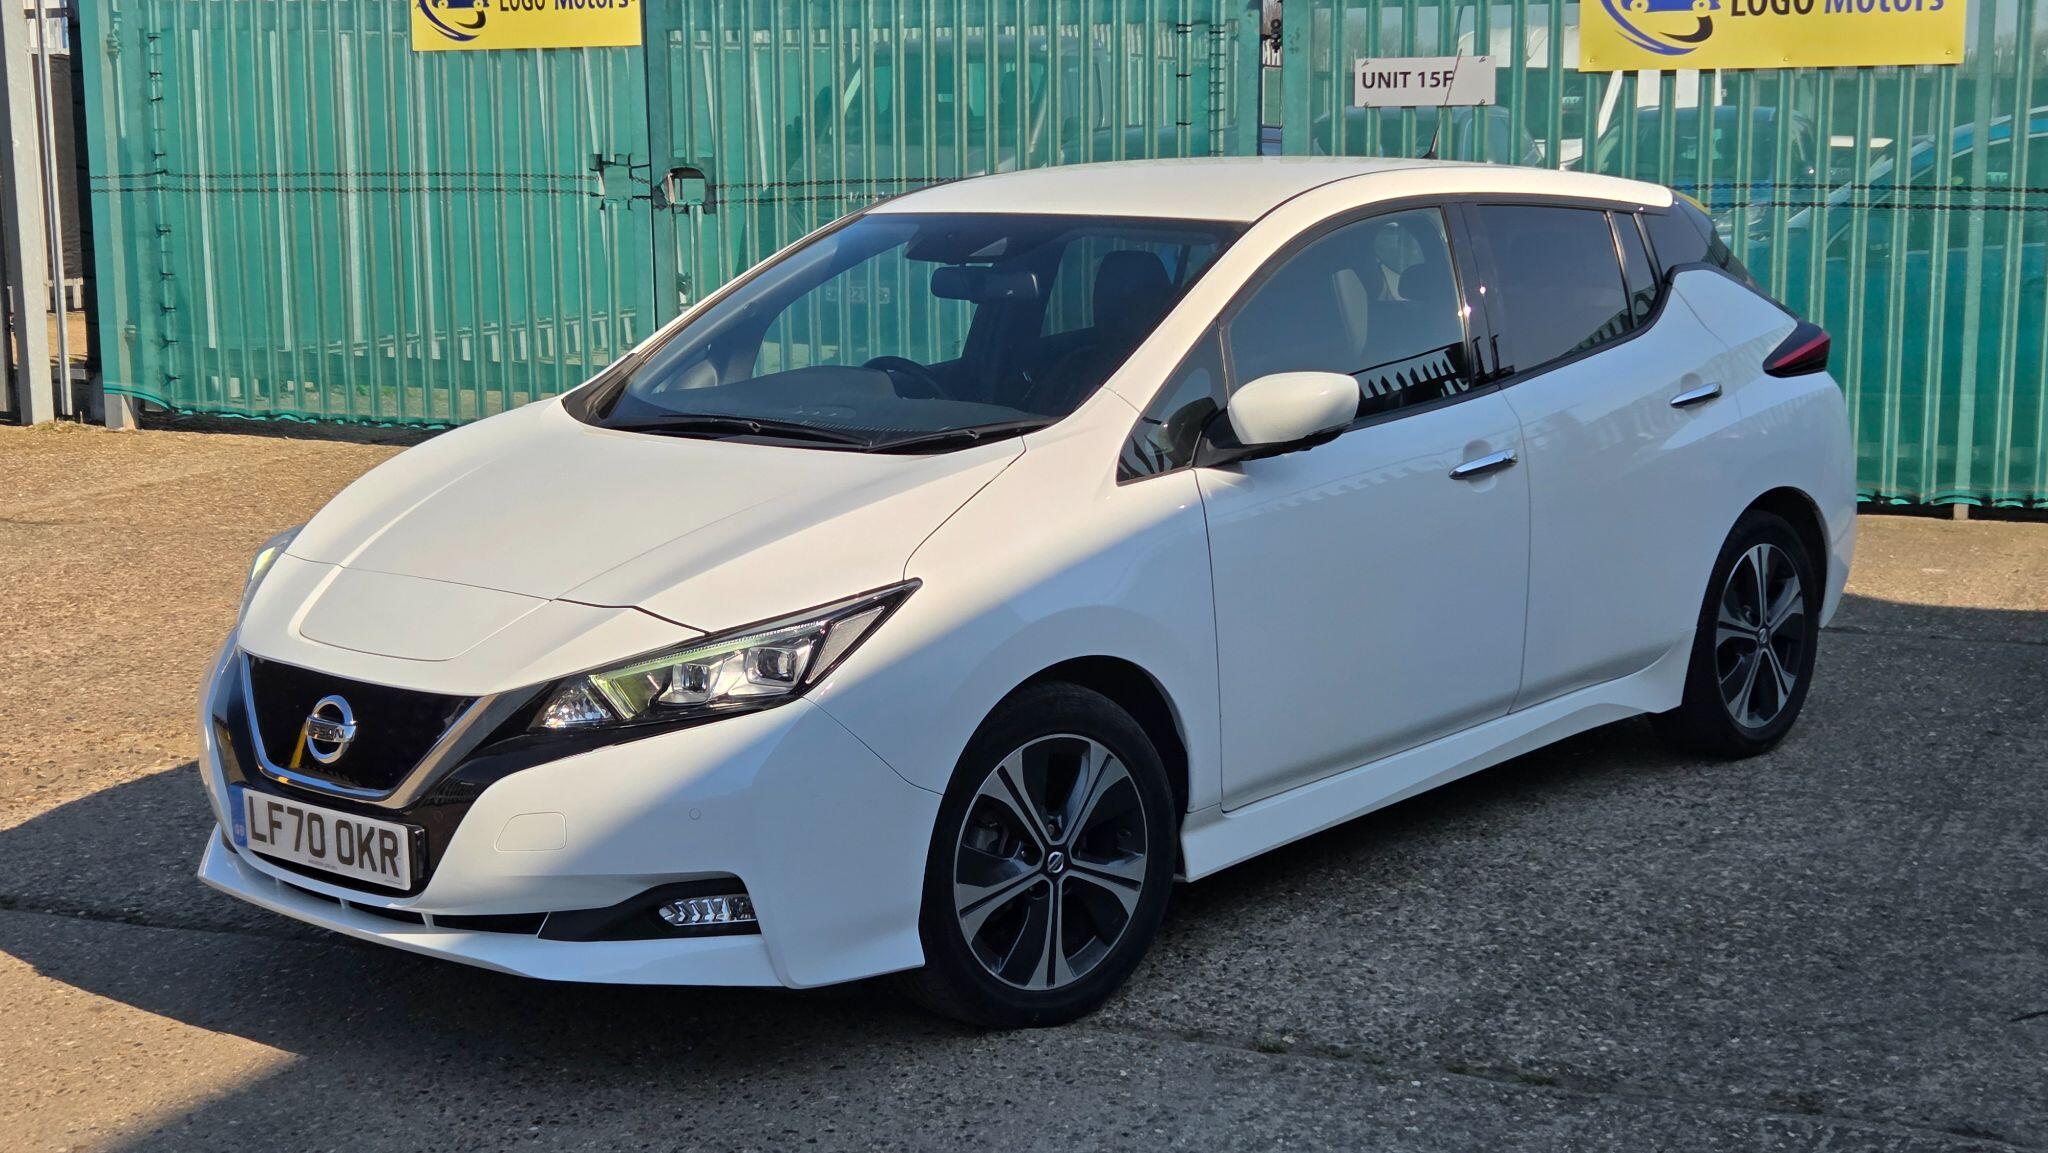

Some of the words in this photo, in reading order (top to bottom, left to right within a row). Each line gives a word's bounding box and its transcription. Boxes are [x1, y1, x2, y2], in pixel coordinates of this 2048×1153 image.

[1362, 71, 1411, 88] UNIT
[1417, 70, 1455, 88] 15F
[309, 722, 344, 739] SSAN
[248, 797, 326, 859] LF70
[335, 821, 400, 878] OKR
